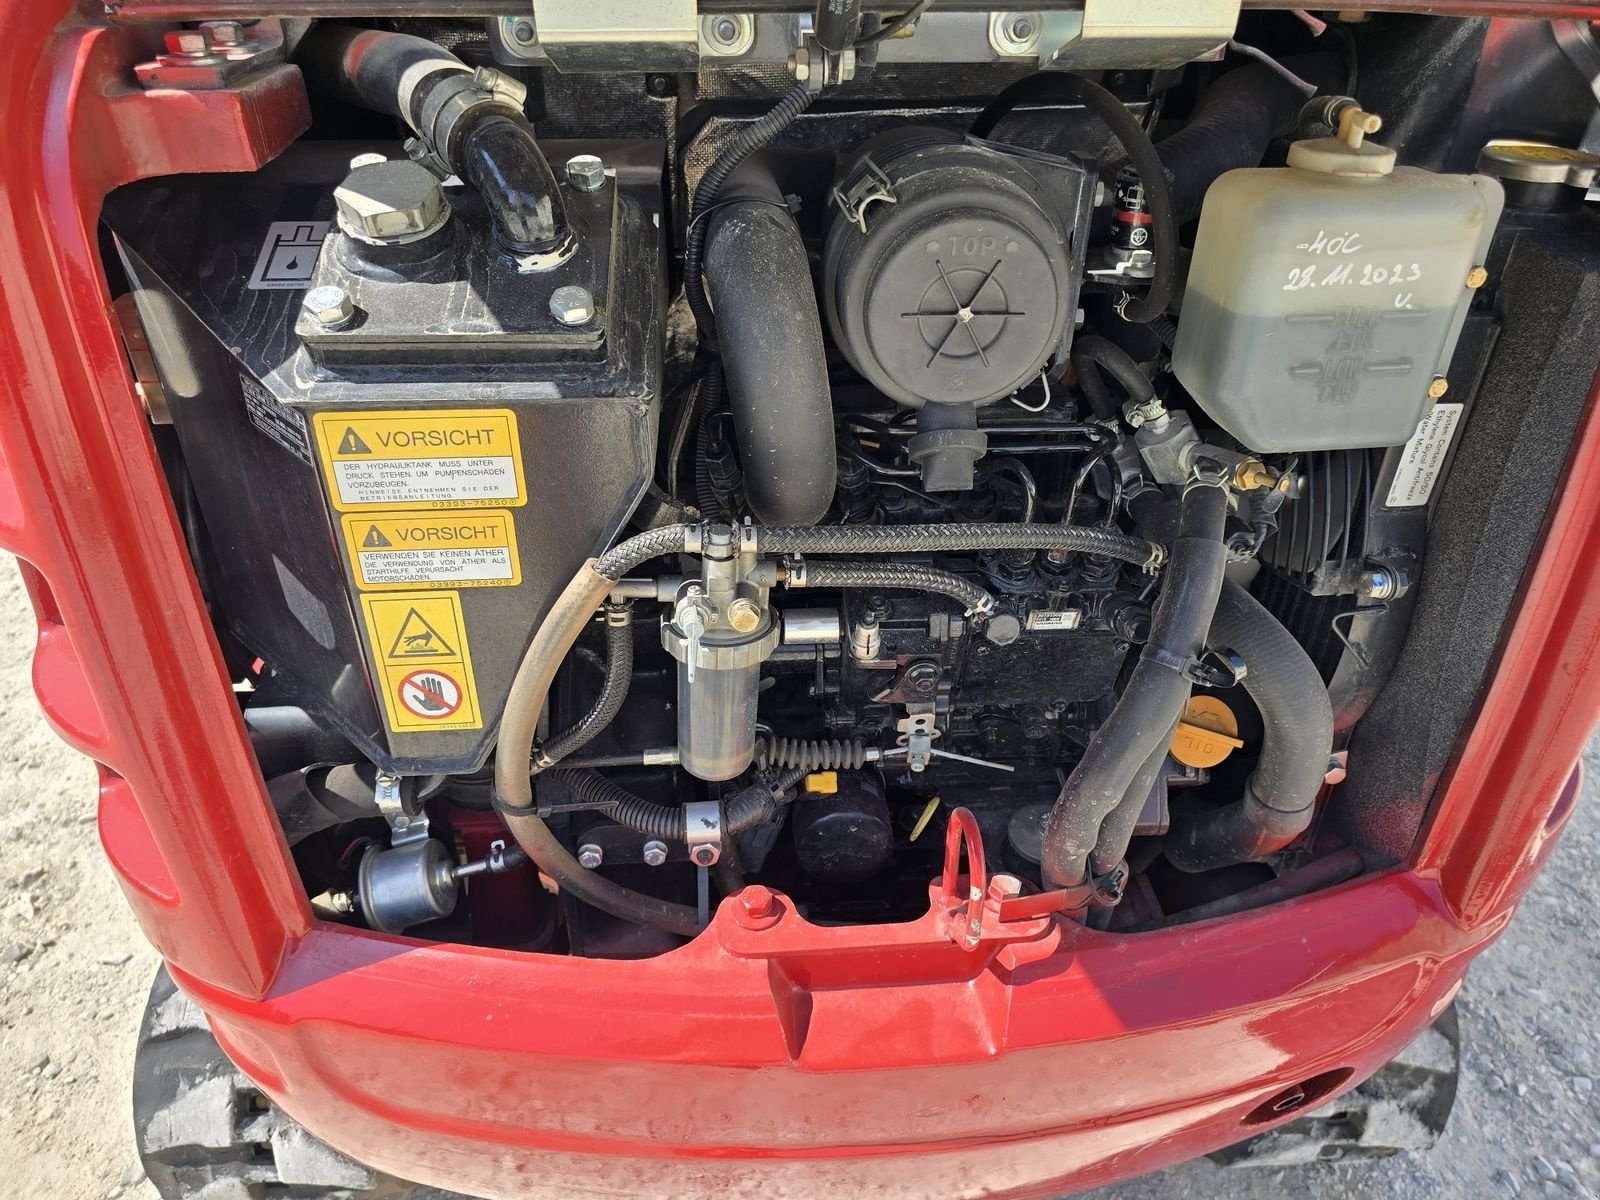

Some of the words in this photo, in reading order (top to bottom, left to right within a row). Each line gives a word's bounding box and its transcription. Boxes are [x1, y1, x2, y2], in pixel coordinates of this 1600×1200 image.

[947, 235, 997, 257] TOP
[1429, 410, 1446, 441] Ethylene
[1441, 409, 1457, 436] System
[375, 429, 495, 447] VORSICHT
[1408, 438, 1424, 465] Mixture
[1419, 443, 1433, 465] Glycol
[1429, 439, 1446, 468] Contains
[344, 463, 361, 471] DER
[367, 461, 433, 470] HYDRAULIKTANK
[439, 460, 462, 468] MUSS
[467, 459, 494, 467] UNTER
[346, 472, 375, 480] DRUCK
[416, 470, 429, 478] UM
[1405, 467, 1424, 502] Antifreeze
[1419, 471, 1434, 495] 50/50
[395, 525, 499, 543] VORSICHT
[364, 551, 419, 561] VERWENDEN
[423, 551, 437, 559] SIE
[439, 550, 471, 559] KEINEN
[382, 560, 434, 568] VERWENDUNG
[366, 567, 410, 575] STARTHILFE
[415, 566, 465, 574] VERURSACHT
[1185, 736, 1214, 754] OIL
